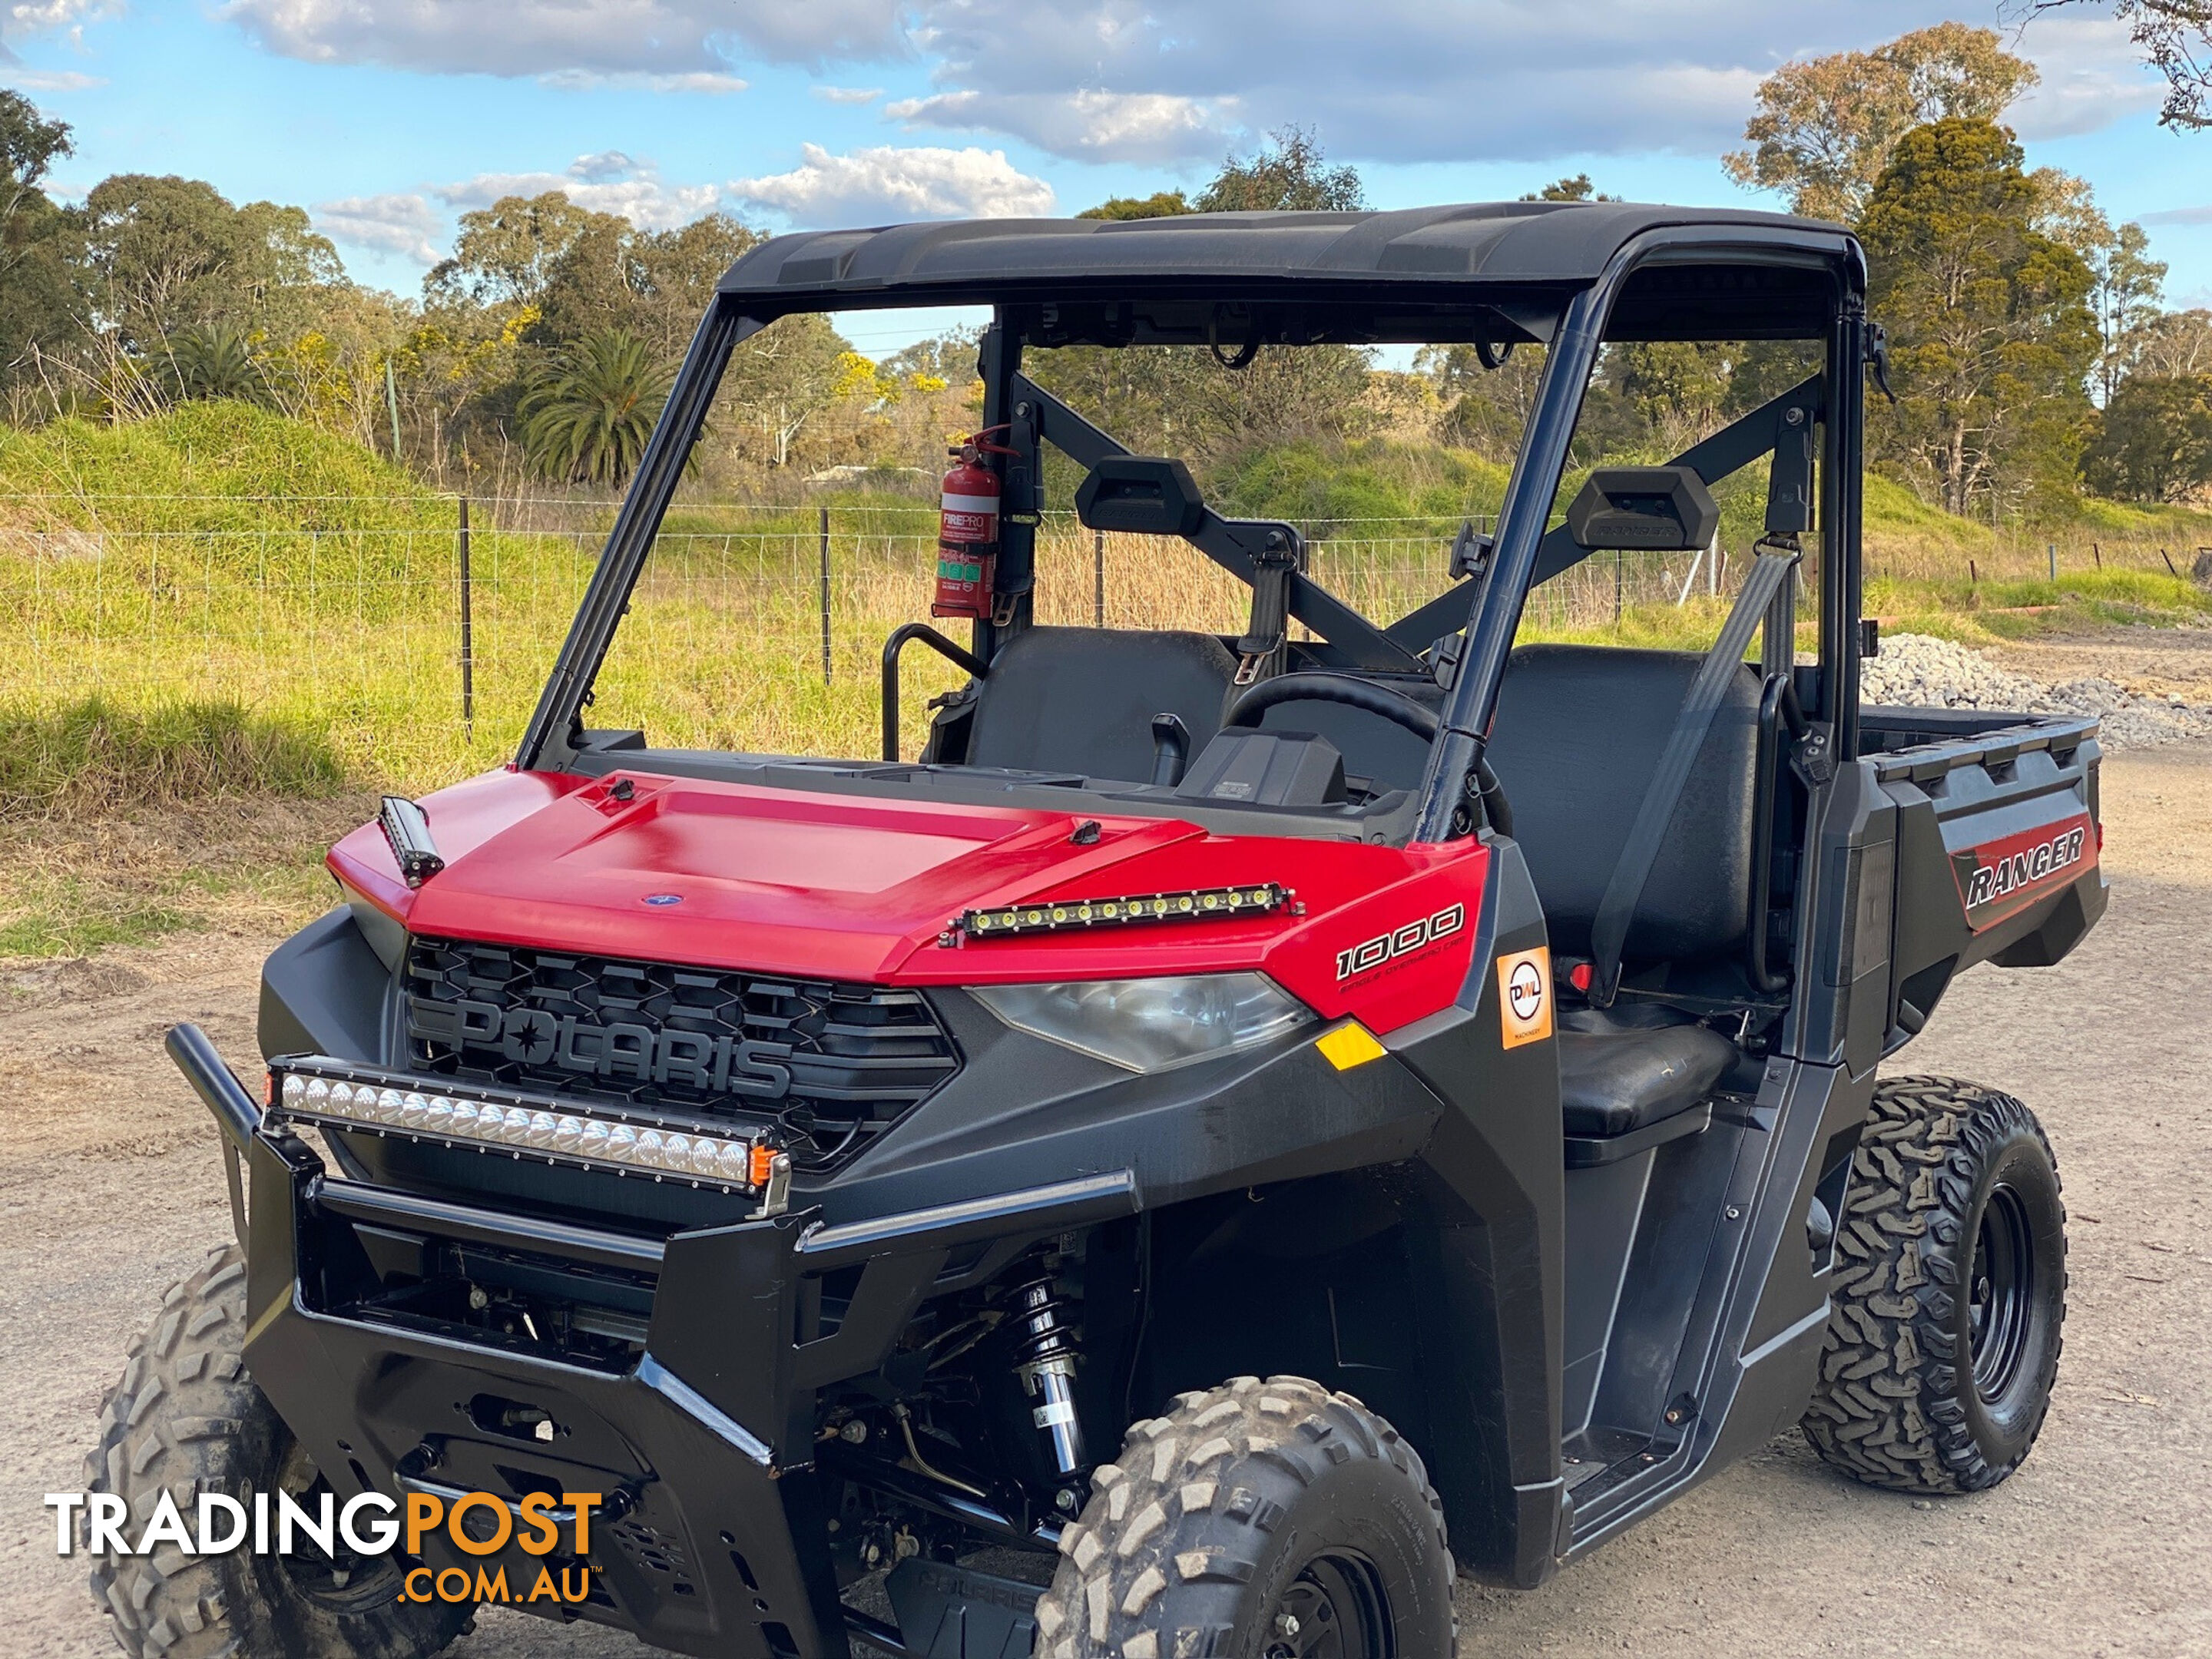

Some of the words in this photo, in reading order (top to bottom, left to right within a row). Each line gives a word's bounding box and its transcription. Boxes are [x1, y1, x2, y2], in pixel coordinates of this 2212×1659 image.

[943, 513, 984, 528] FIREPRO
[1965, 826, 2085, 909] RANGER
[1336, 902, 1465, 981] 1000
[1510, 981, 1541, 1001] DWL
[450, 998, 793, 1101] POLARIS
